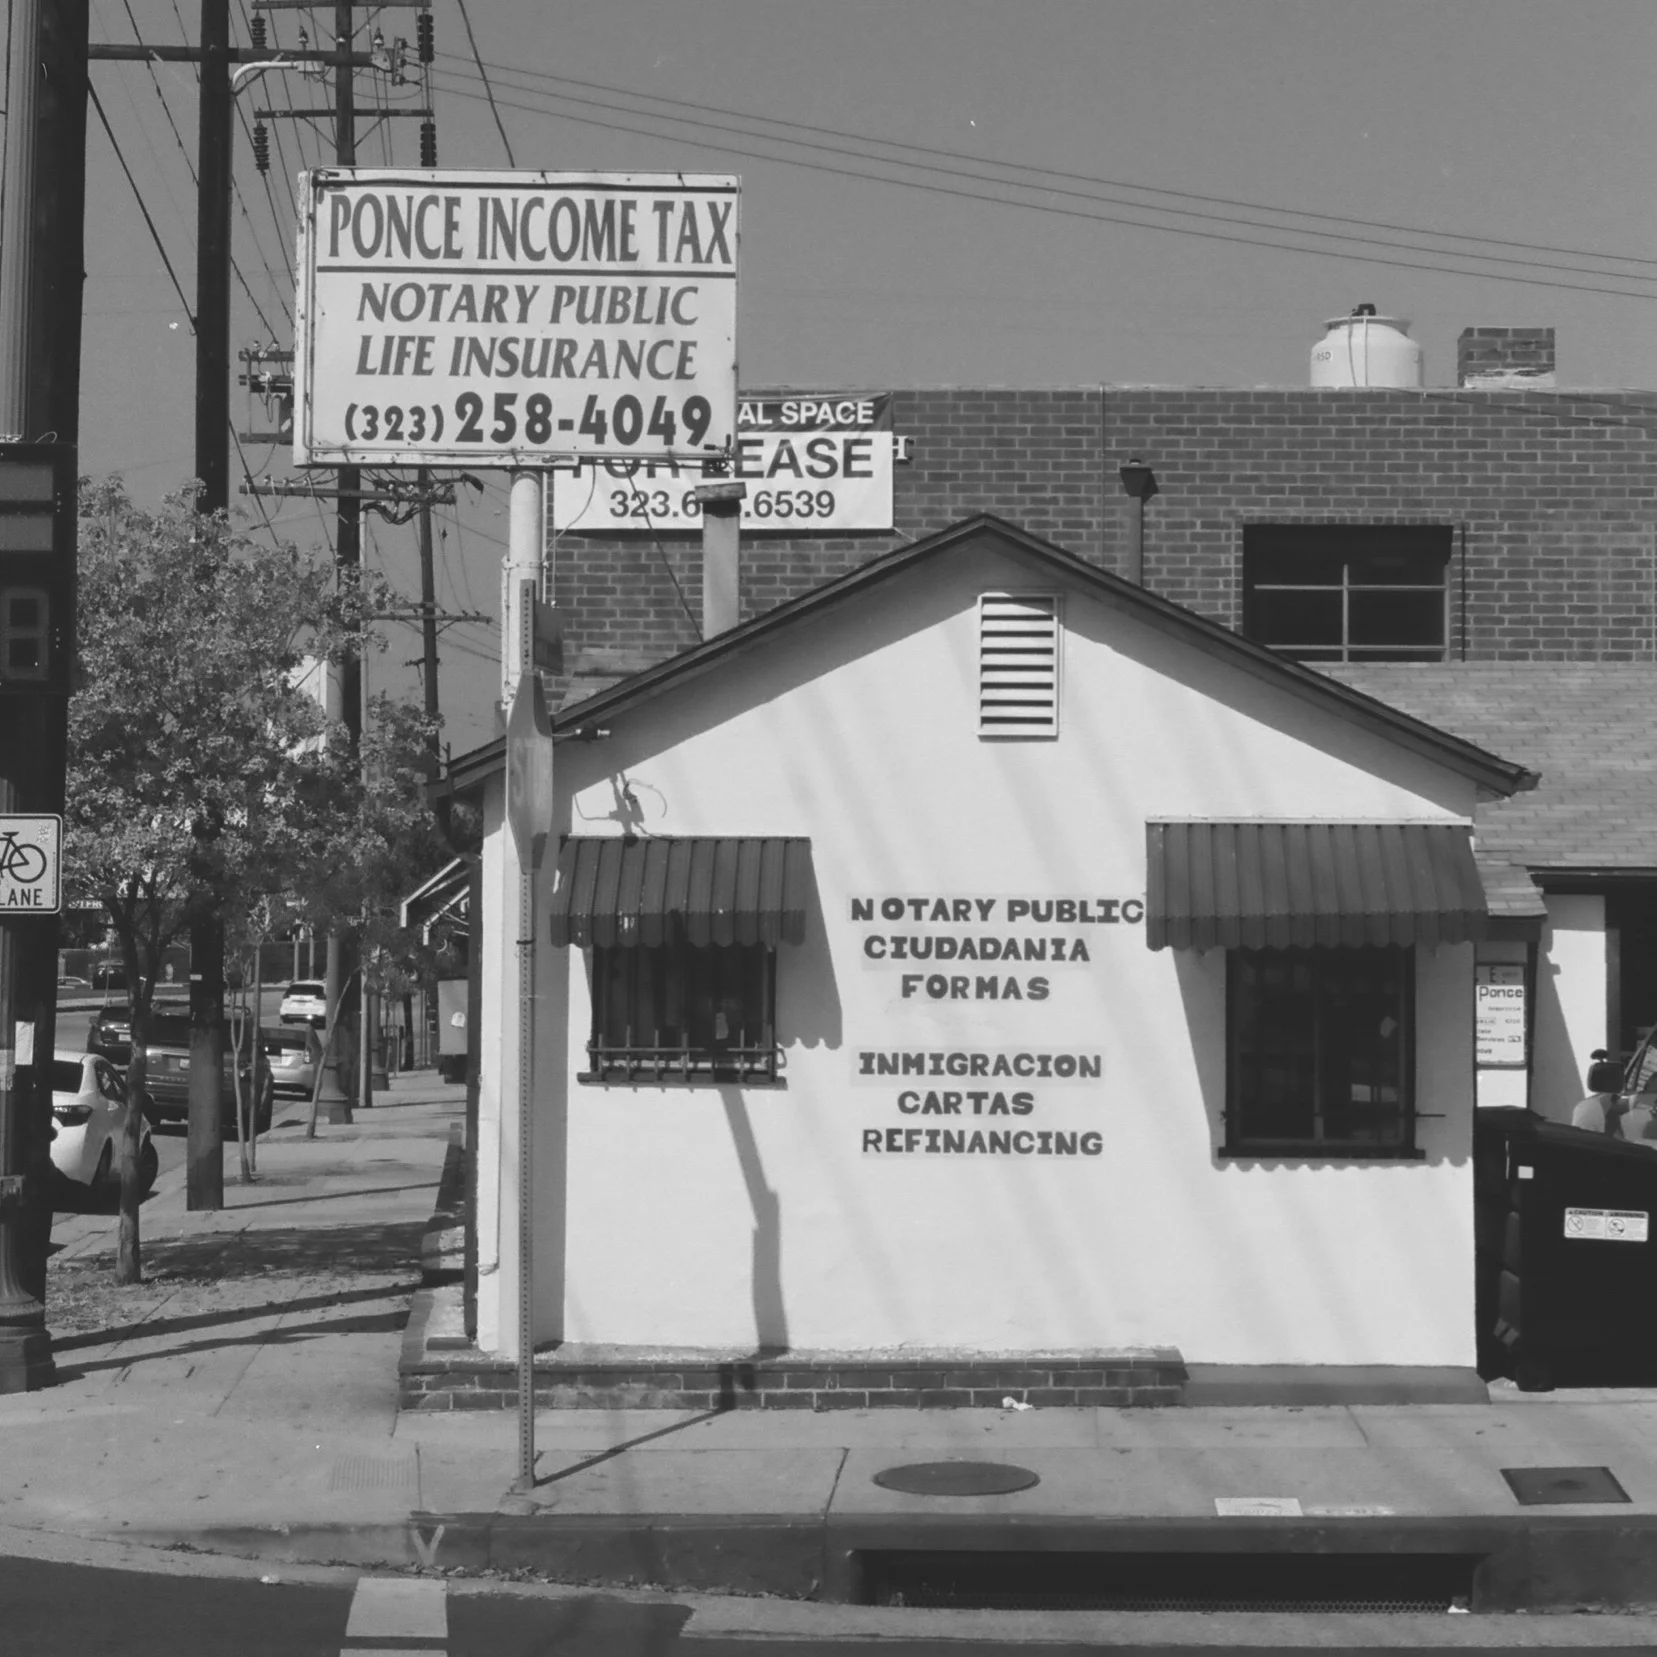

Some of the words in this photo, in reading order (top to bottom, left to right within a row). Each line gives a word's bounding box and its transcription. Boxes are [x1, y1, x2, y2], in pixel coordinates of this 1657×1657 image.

[328, 192, 463, 260] PONCE
[476, 191, 641, 264] INCOME
[651, 200, 734, 265] TAX
[356, 282, 541, 324] NOTARY
[549, 285, 699, 327] PUBLIC
[355, 335, 436, 377] LIFE
[448, 336, 698, 381] INSURANCE
[344, 403, 445, 443] (323)
[454, 391, 713, 447] 258-4049
[780, 401, 875, 425] SPACE
[609, 488, 836, 518] 323.6.6539
[851, 897, 997, 922] NOTARY
[1007, 899, 1144, 924] PUBLIC
[863, 935, 1091, 962] CIUDADANIA
[901, 974, 1050, 1001] FORMAS
[1479, 986, 1523, 1002] Ponce
[859, 1052, 1101, 1078] INMIGRACION
[897, 1091, 1034, 1116] CARTAS
[862, 1128, 1103, 1156] REFINANCING
